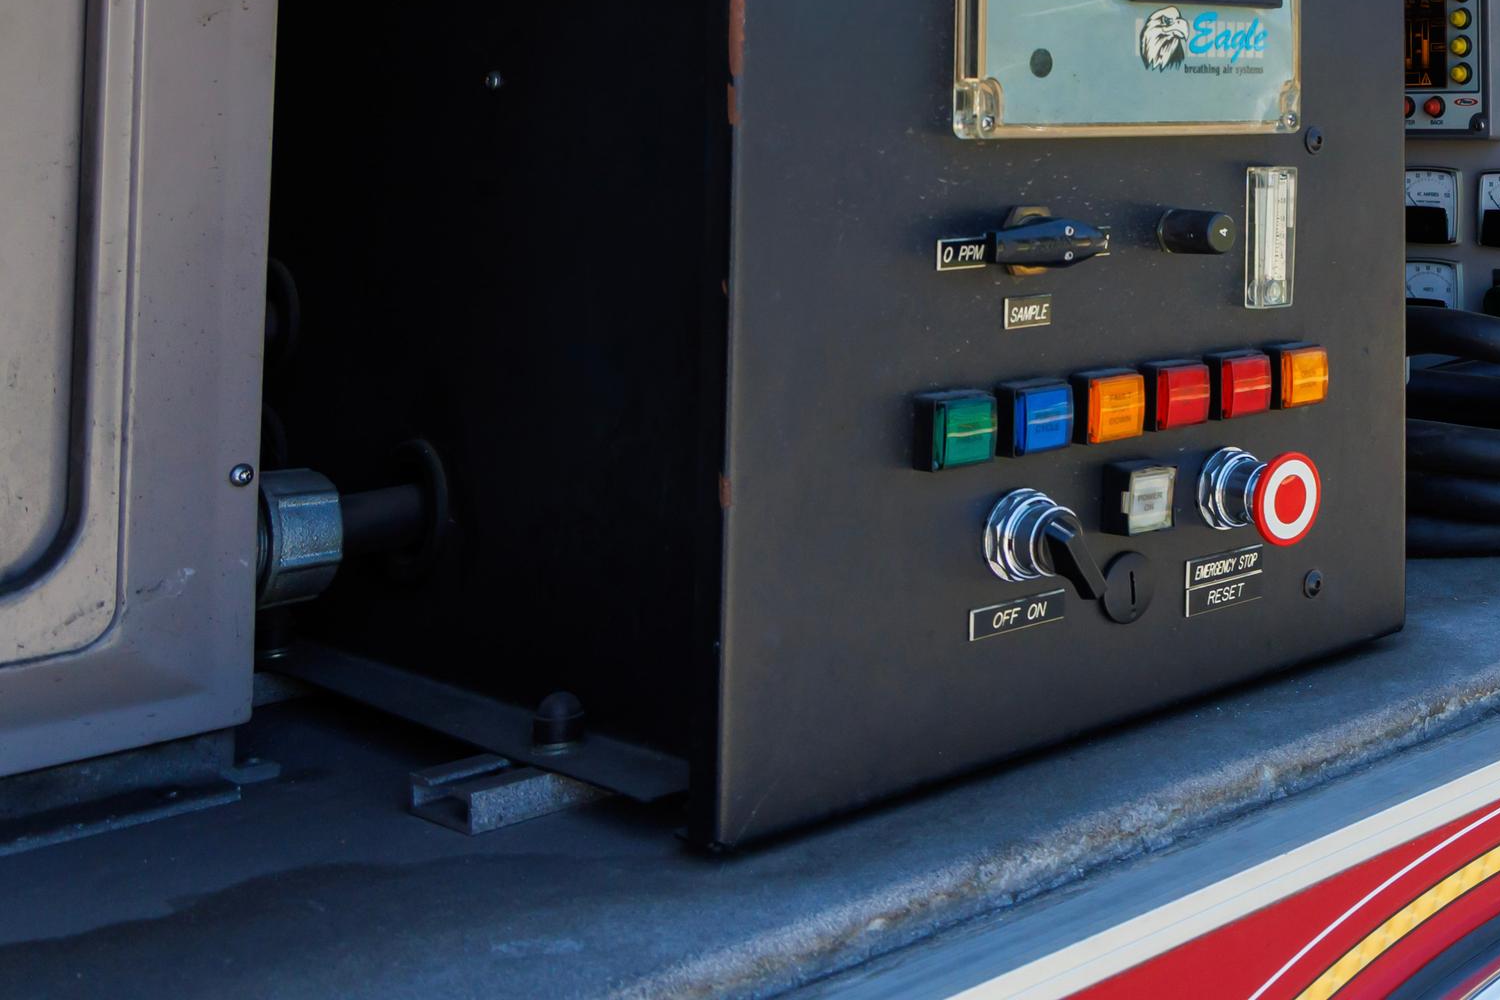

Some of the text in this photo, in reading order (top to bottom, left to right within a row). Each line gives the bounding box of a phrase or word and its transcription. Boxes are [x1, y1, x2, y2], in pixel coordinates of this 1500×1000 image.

[1188, 11, 1269, 63] Eagle
[1184, 63, 1264, 77] breathing air systems
[958, 244, 985, 262] PPM
[1010, 303, 1049, 323] SAMPLE
[1194, 552, 1258, 581] EMERGENCY STOP
[1207, 582, 1245, 605] RESET
[992, 601, 1047, 629] OFF ON
